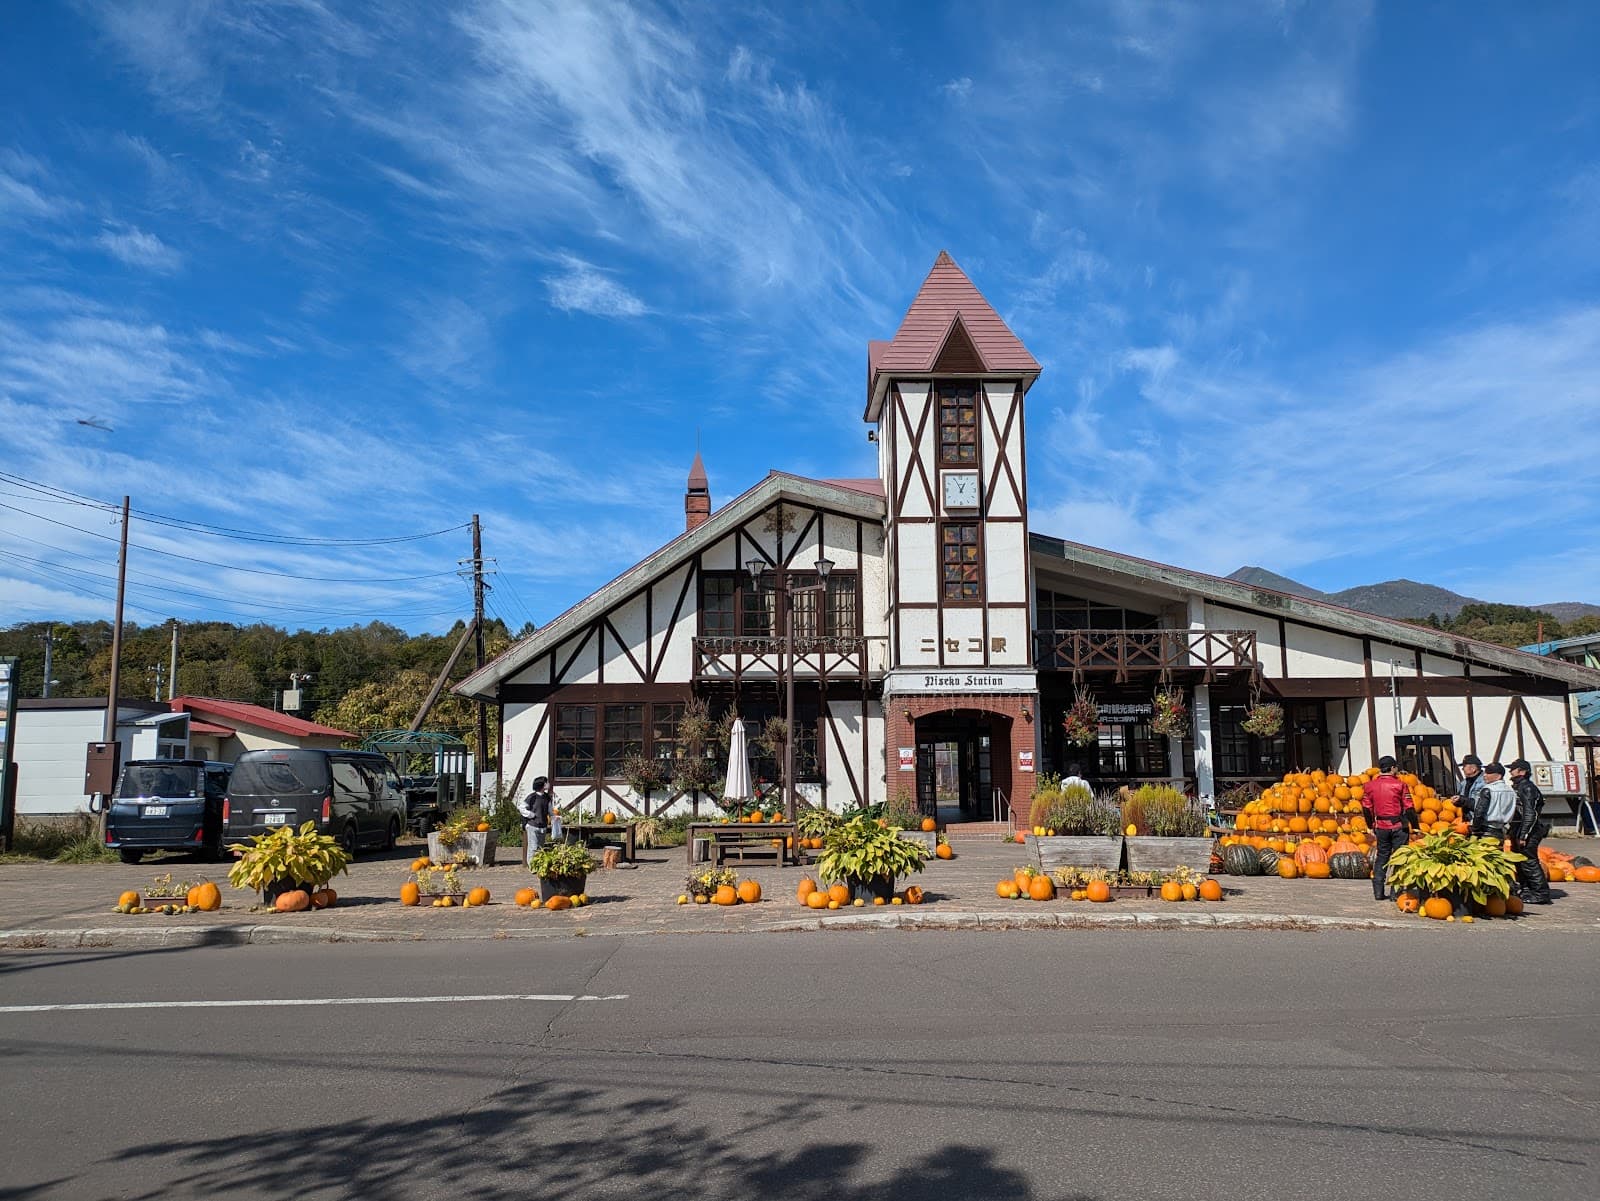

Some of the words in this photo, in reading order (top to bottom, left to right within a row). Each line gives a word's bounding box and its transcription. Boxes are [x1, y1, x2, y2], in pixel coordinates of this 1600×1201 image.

[920, 637, 1007, 653] ニセコ駅
[964, 675, 1003, 687] Station
[1096, 703, 1152, 714] コ町観光案内所
